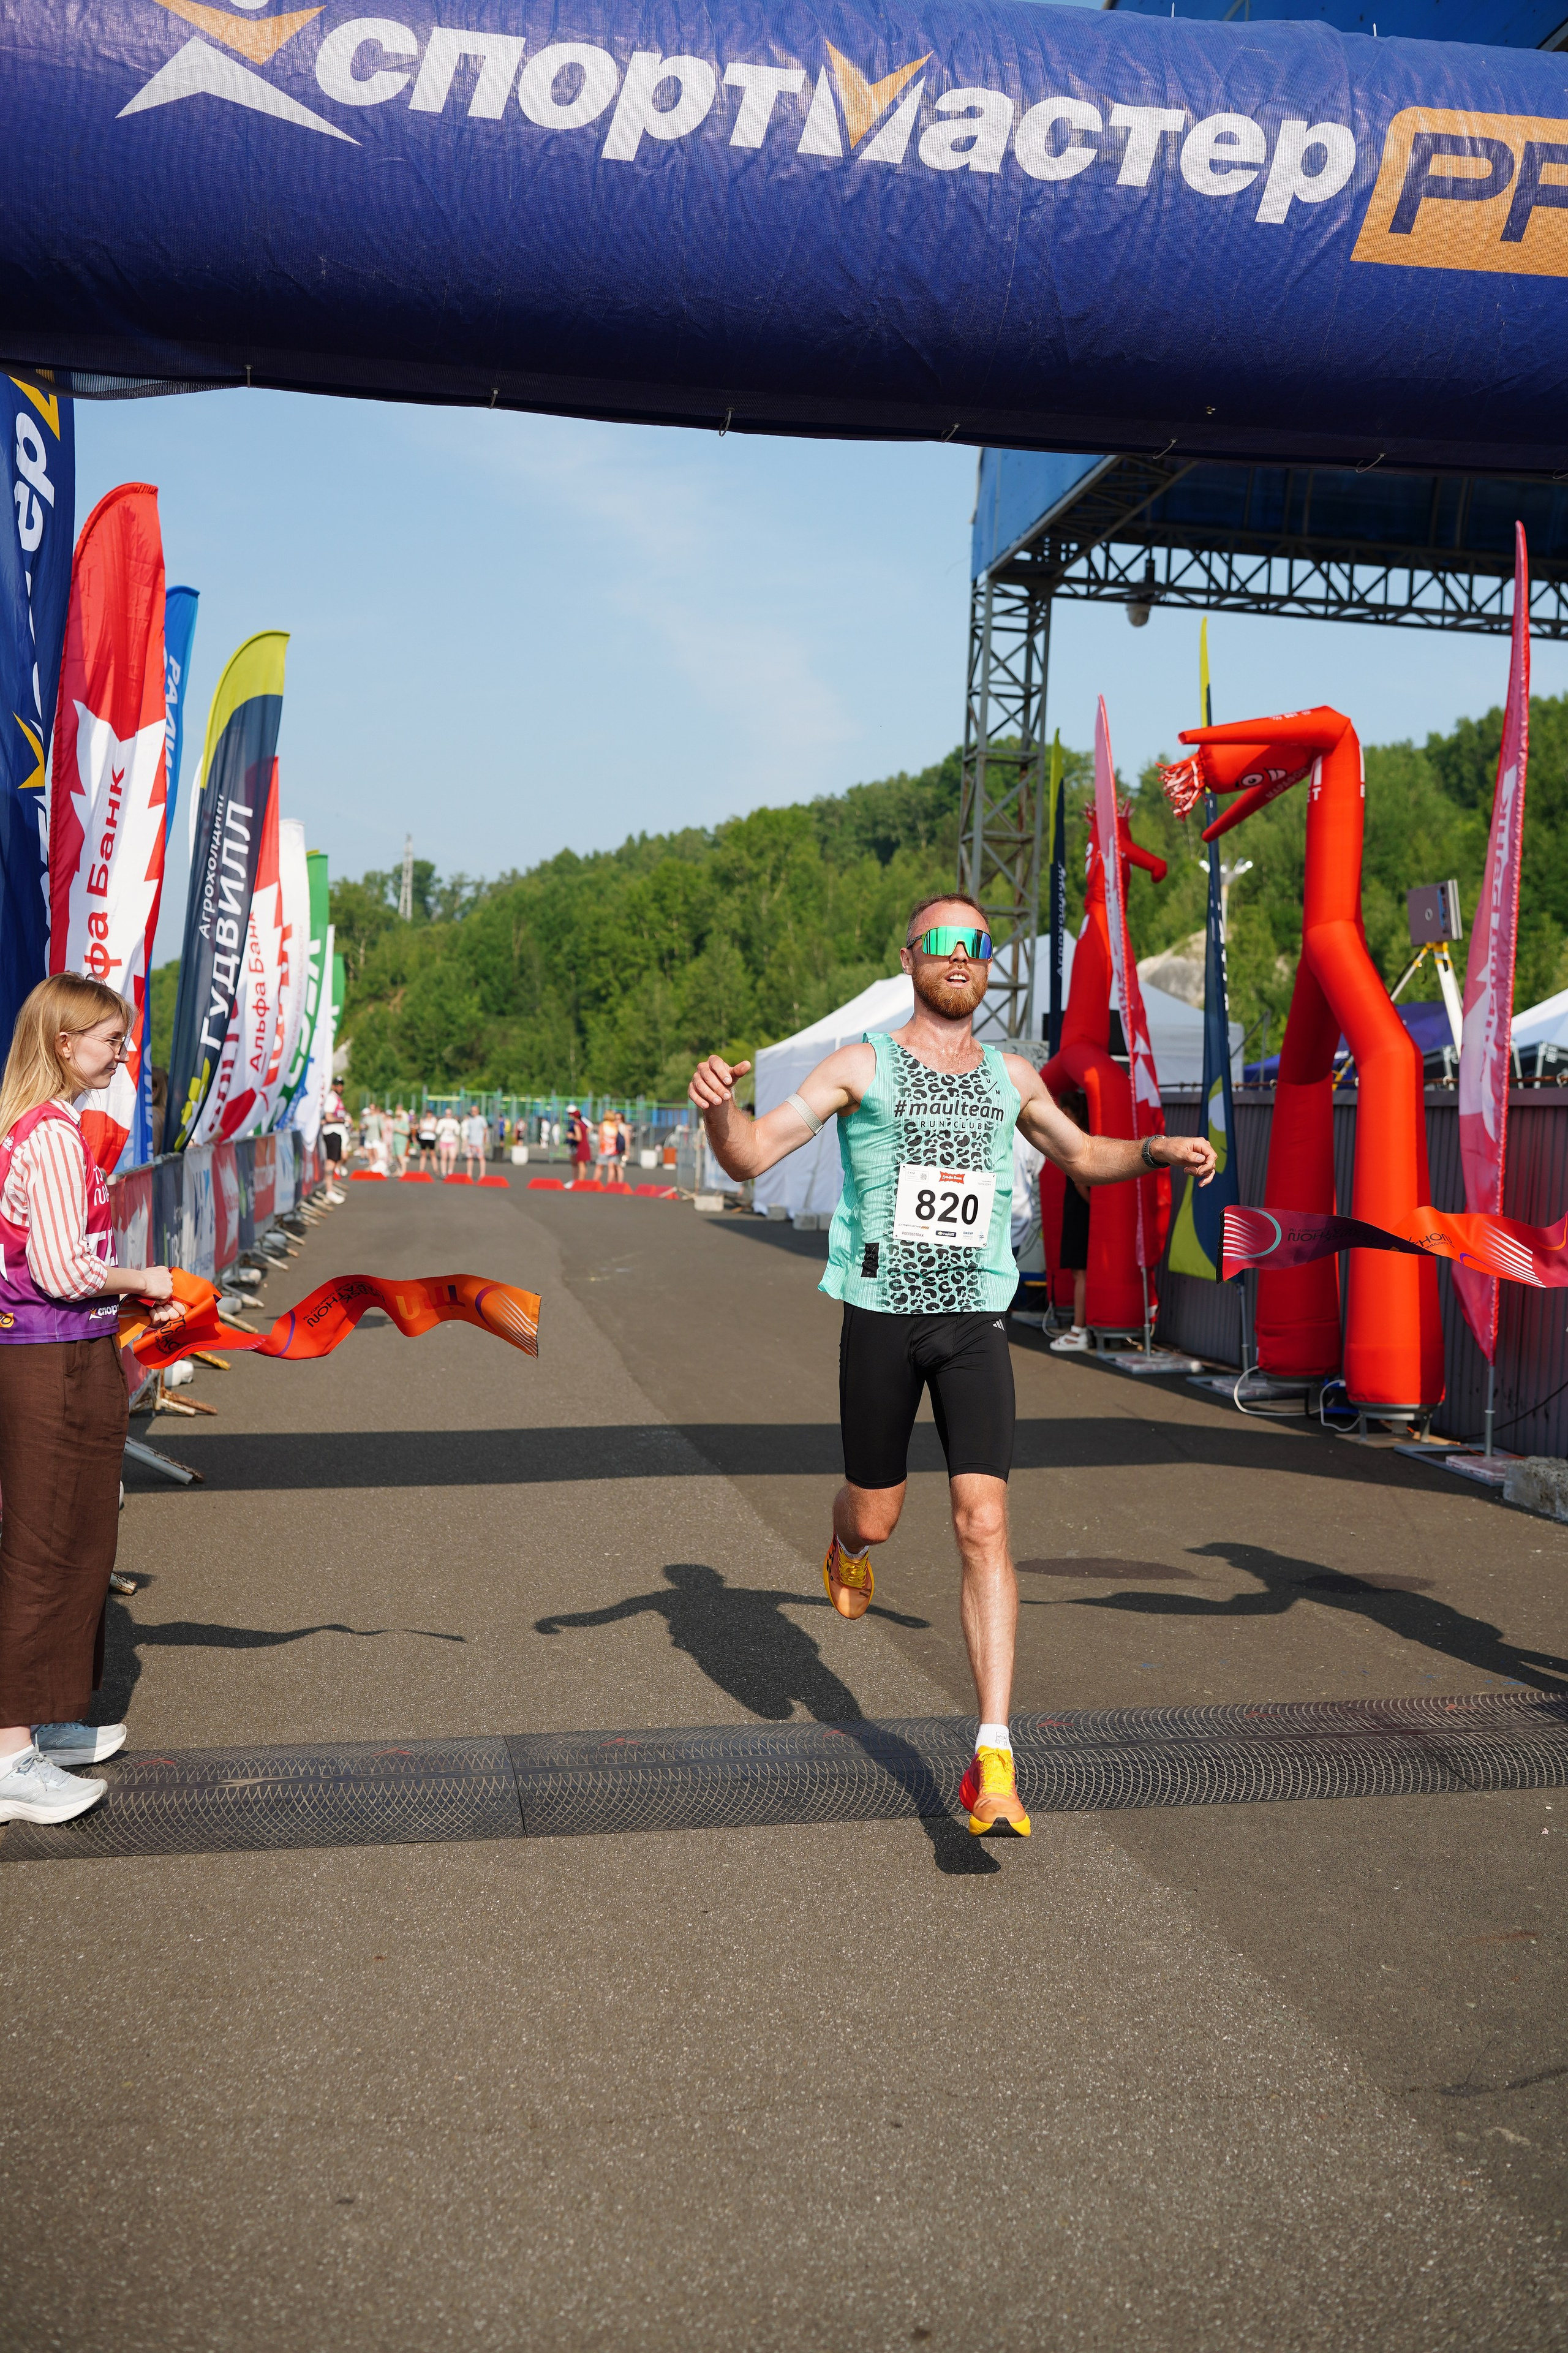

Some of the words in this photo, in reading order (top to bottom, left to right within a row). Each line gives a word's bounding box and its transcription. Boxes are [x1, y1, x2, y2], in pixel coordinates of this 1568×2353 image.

[86, 764, 125, 897] Банк
[200, 799, 253, 1051] ГУДВИЛЛ
[250, 982, 270, 1072] Альфа
[894, 1100, 1004, 1122] #maulteam
[915, 1189, 979, 1225] 820
